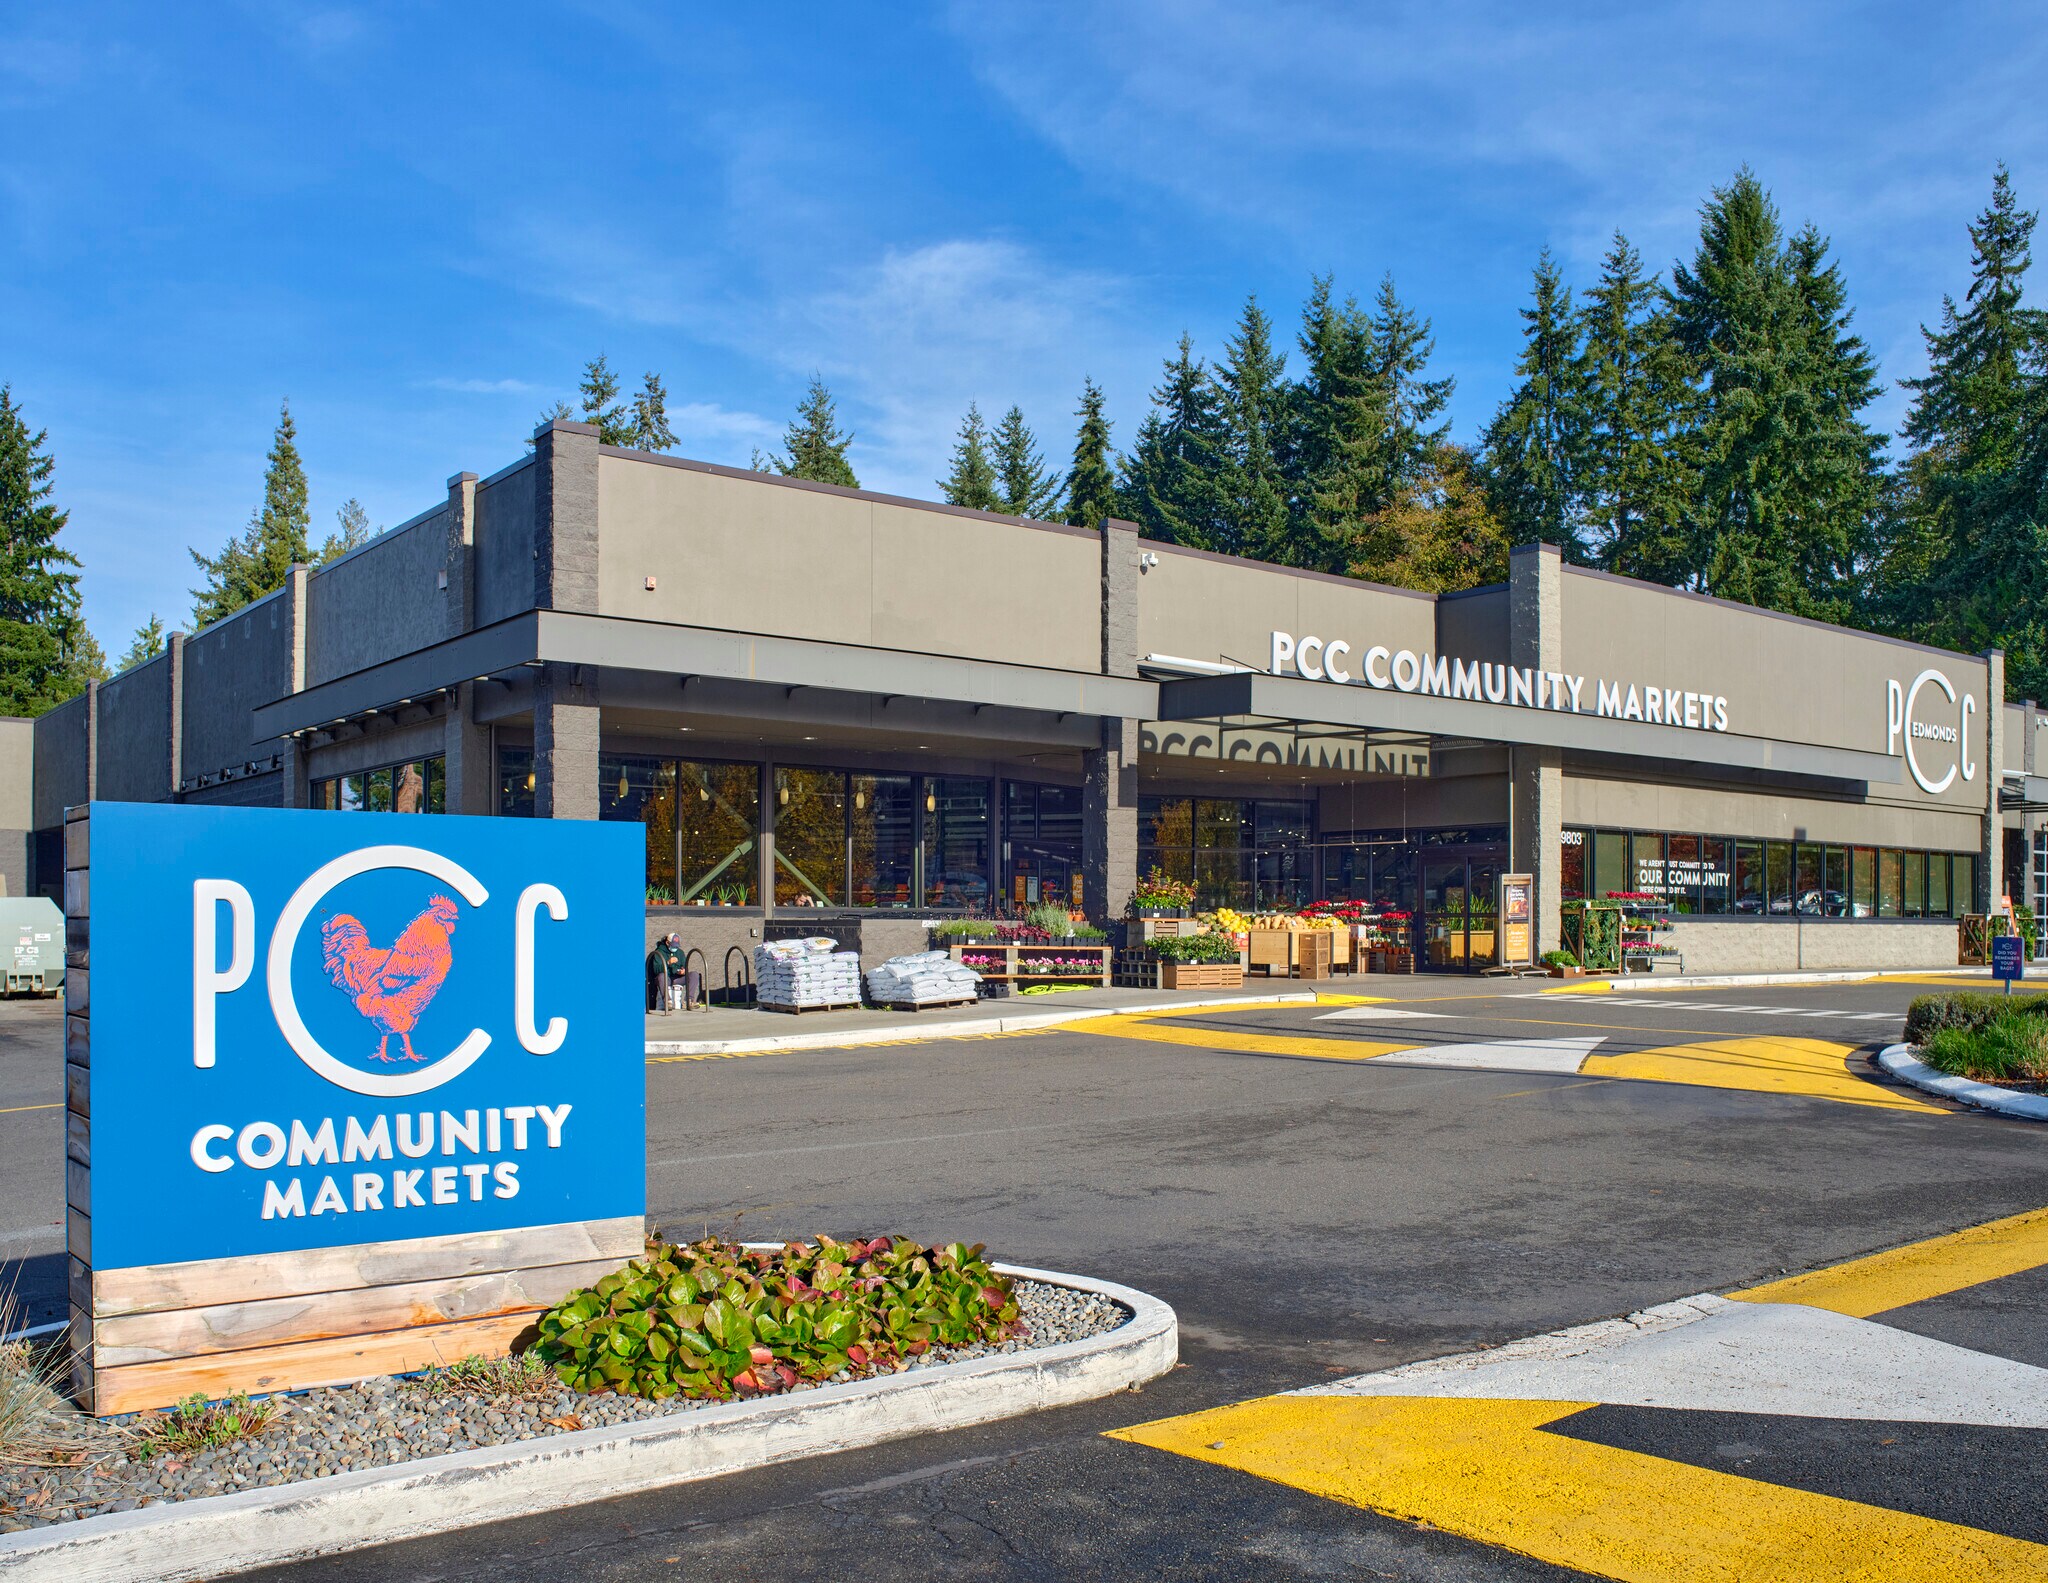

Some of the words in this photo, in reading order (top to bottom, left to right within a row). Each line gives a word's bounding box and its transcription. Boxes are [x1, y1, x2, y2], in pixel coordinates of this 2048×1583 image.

[1270, 631, 1351, 683] PCC
[1363, 645, 1585, 713] COMMUNITY
[1595, 678, 1728, 731] MARKETS
[1887, 669, 1976, 794] PCC
[1911, 721, 1957, 742] EDMONDS
[1560, 831, 1582, 845] 9803
[1639, 859, 1647, 867] WE
[1648, 860, 1665, 868] AREN'T
[1708, 862, 1715, 870] TO
[1639, 869, 1663, 884] OUR
[193, 845, 569, 1097] PCC
[190, 1103, 573, 1173] COMMUNITY
[261, 1161, 521, 1221] MARKETS
